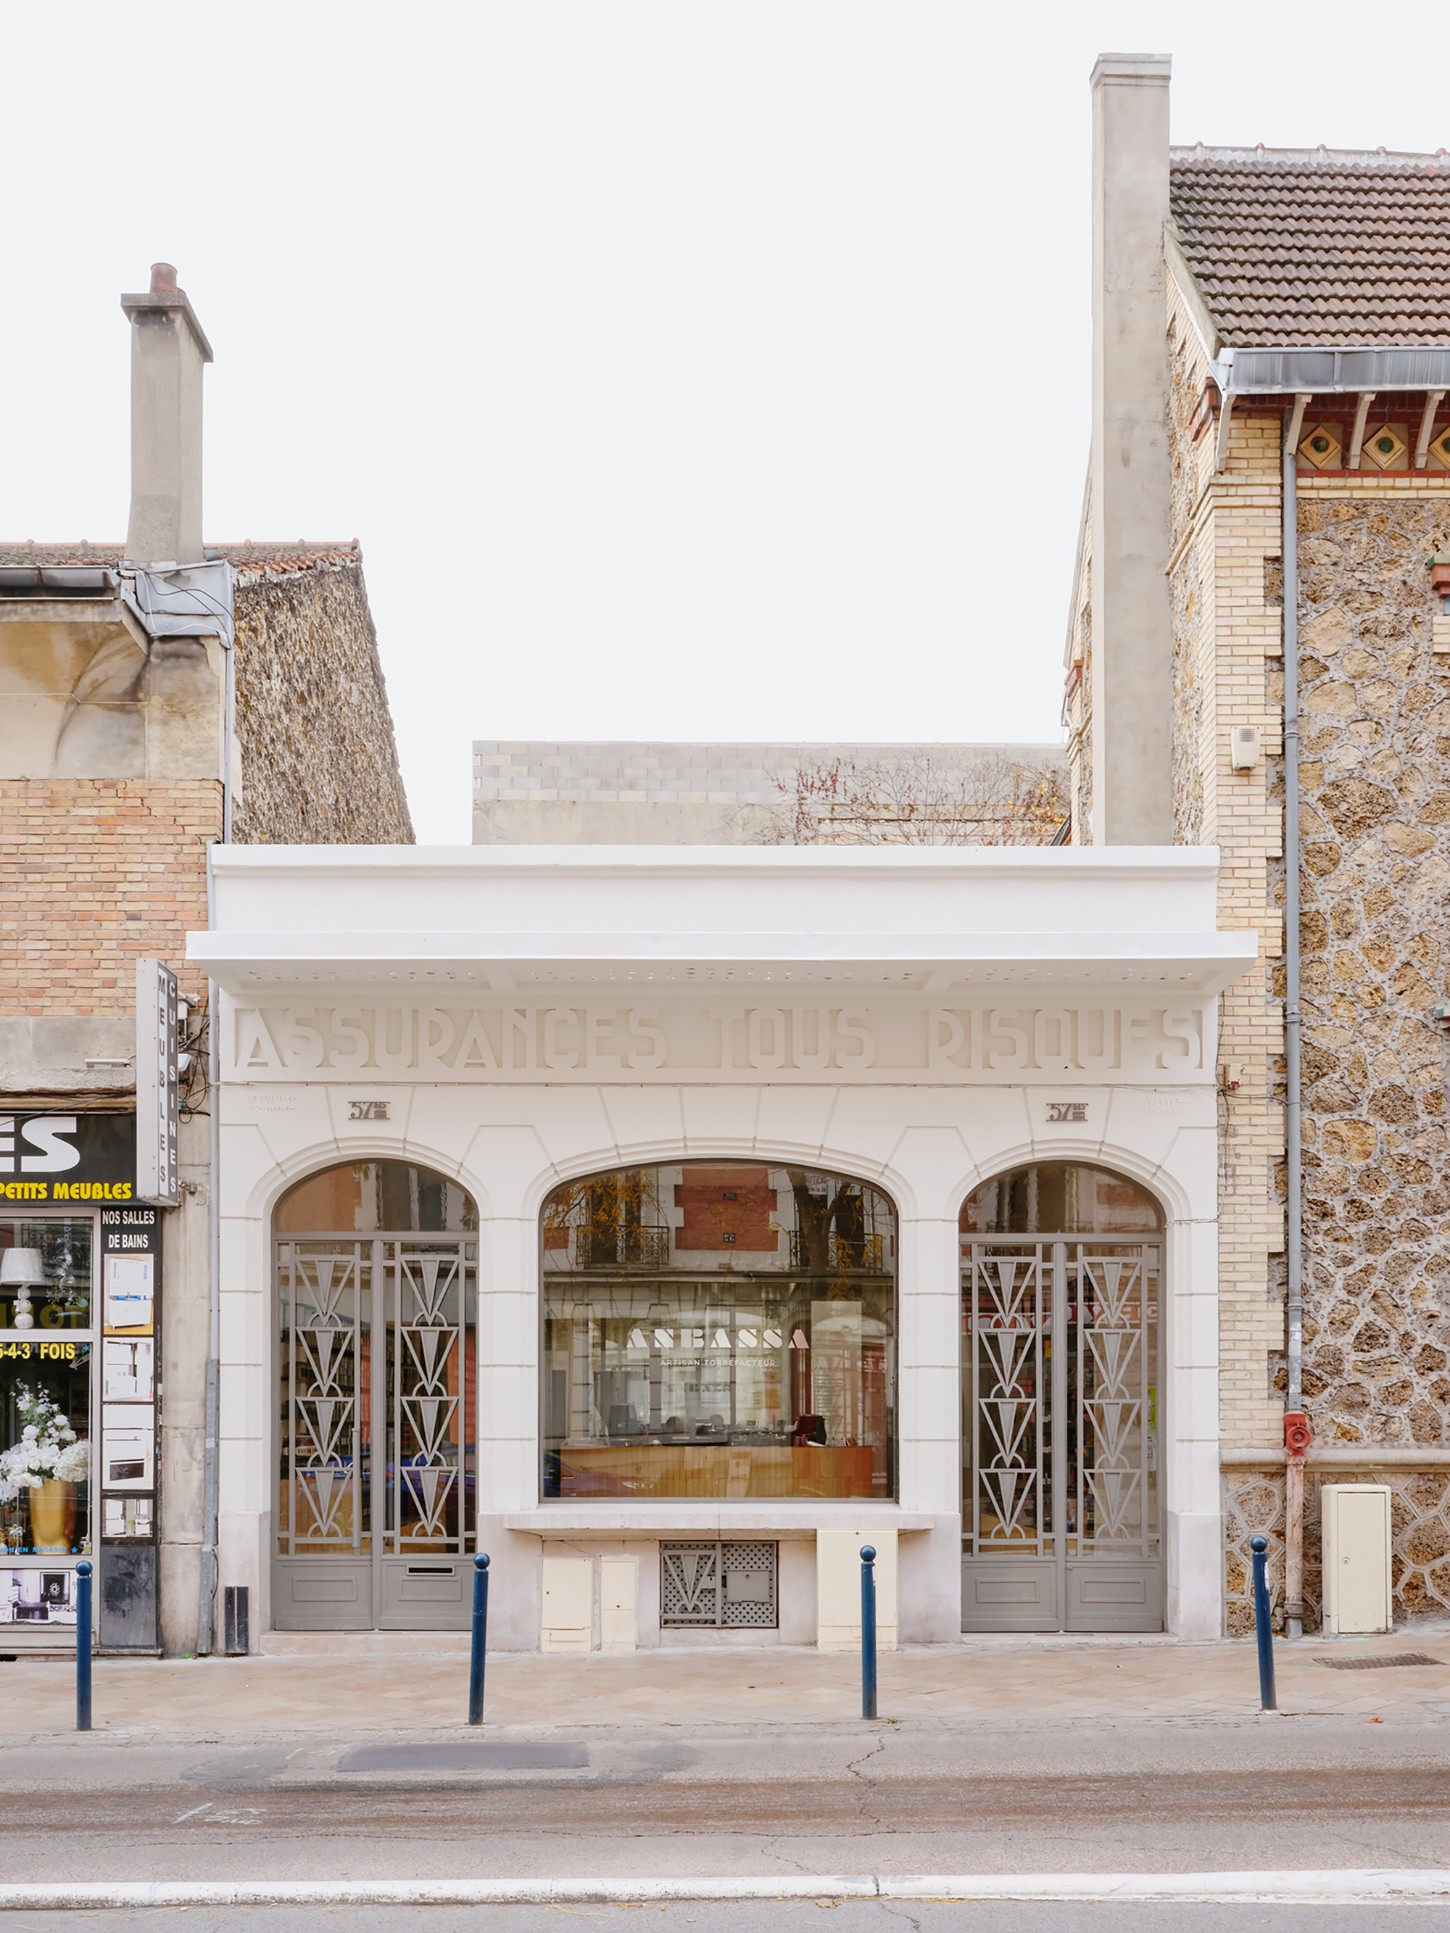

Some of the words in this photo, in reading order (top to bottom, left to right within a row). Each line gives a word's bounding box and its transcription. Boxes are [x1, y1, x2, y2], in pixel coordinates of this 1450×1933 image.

[236, 1007, 668, 1069] ASSURANCES
[708, 1007, 875, 1069] TOUS
[928, 1007, 1202, 1069] RISQUES
[53, 1182, 132, 1200] MEUBLES
[102, 1210, 121, 1225] NOS
[122, 1210, 155, 1225] SALLES
[108, 1234, 120, 1248] DE
[122, 1234, 149, 1248] BAINS
[626, 1328, 810, 1349] ANBASSA
[40, 1342, 76, 1360] FOIS
[660, 1359, 700, 1367] ARTISAN
